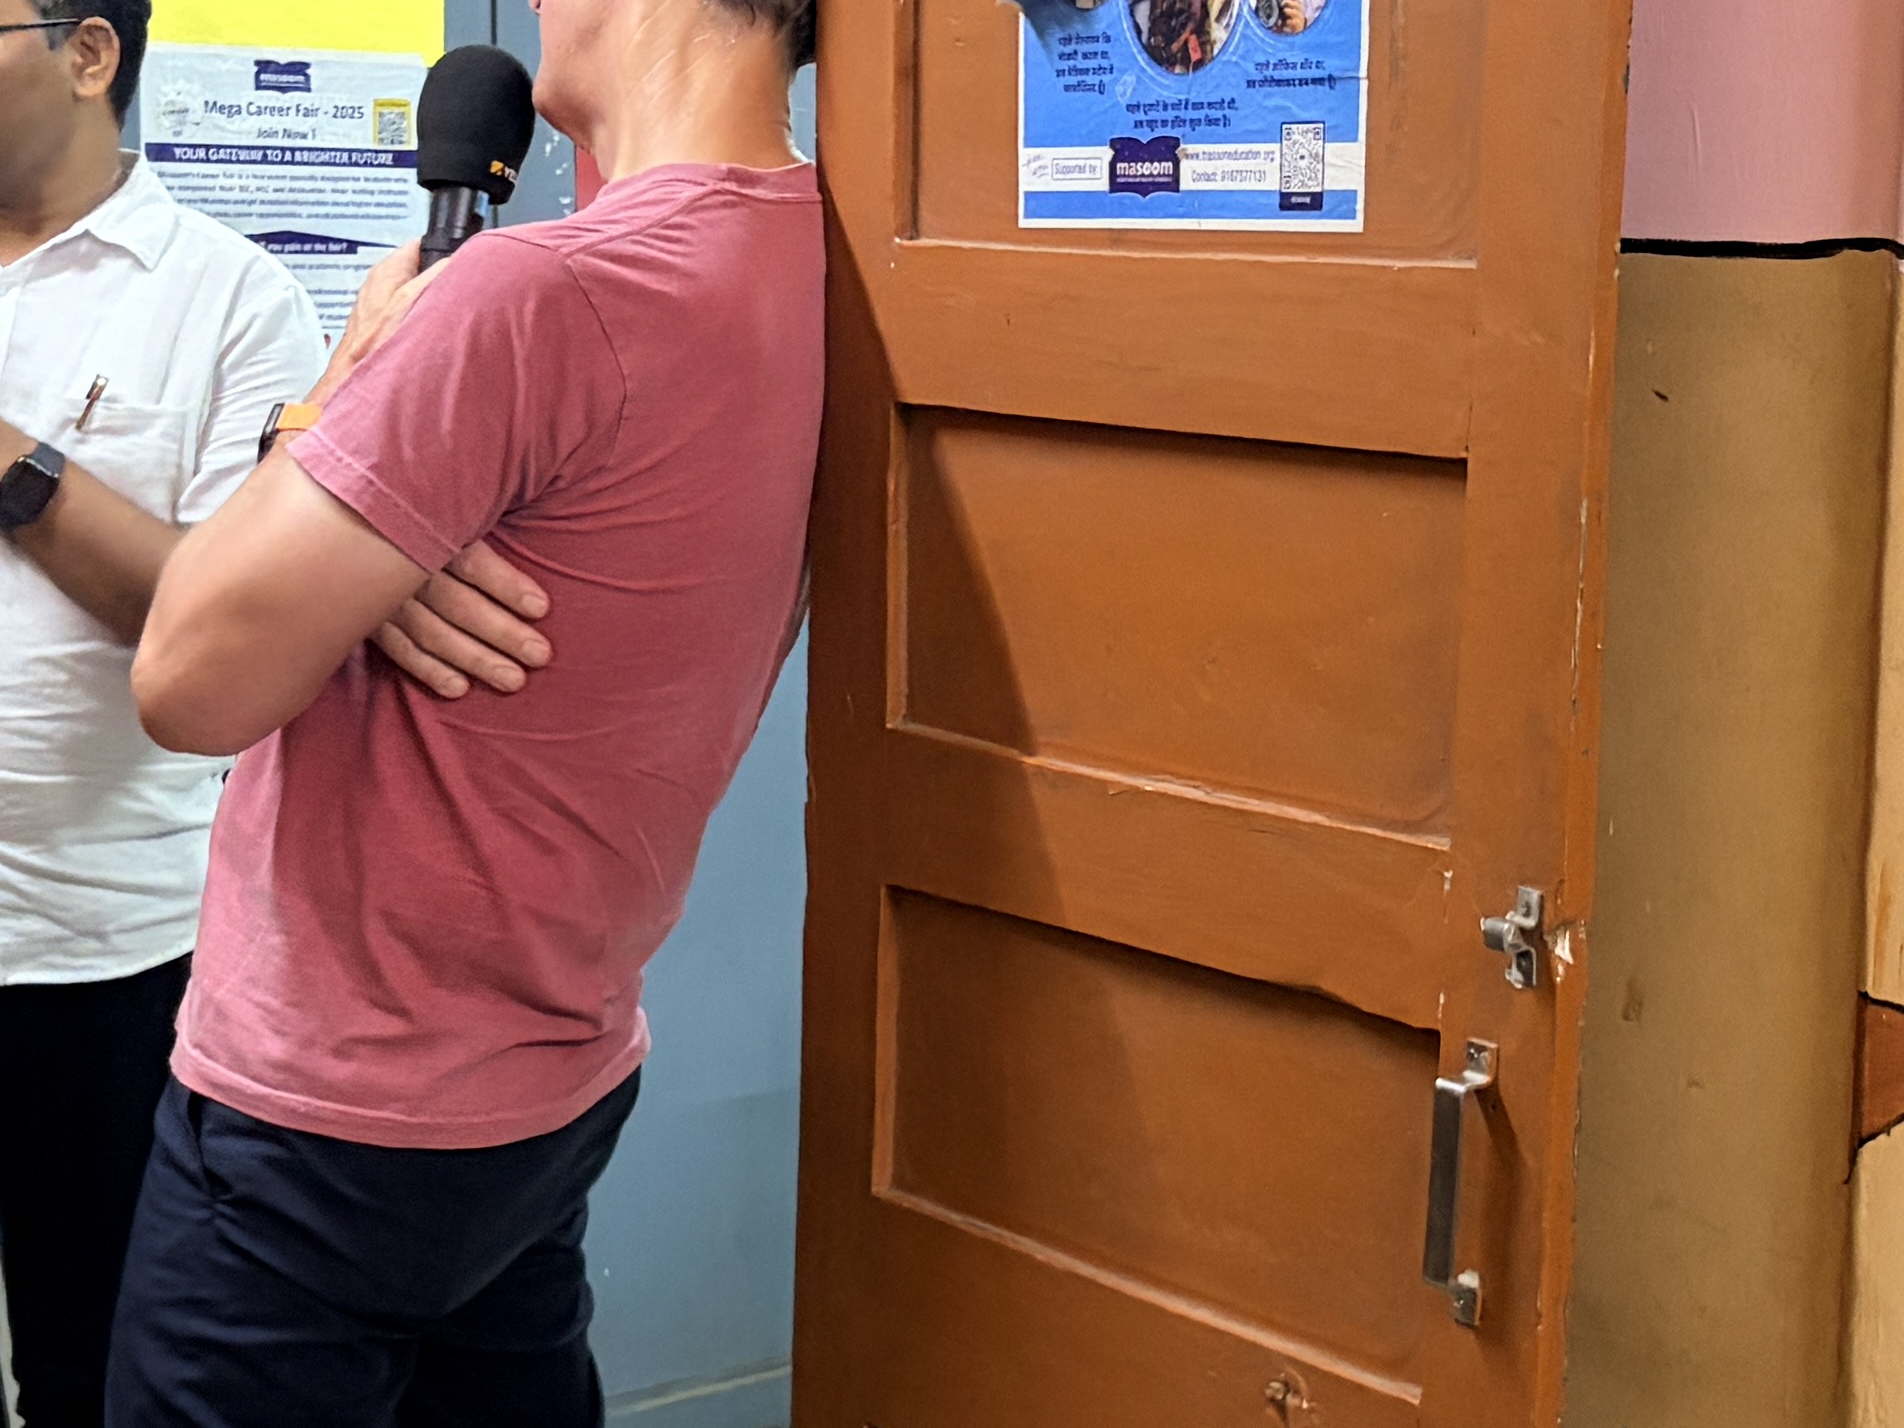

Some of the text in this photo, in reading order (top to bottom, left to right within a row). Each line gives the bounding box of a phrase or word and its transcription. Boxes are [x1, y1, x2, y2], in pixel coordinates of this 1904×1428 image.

[204, 100, 242, 118] Mega
[246, 102, 290, 117] Career
[295, 103, 320, 118] Fair
[332, 105, 365, 120] 2025
[174, 147, 206, 159] YOUR
[266, 149, 282, 162] TO
[283, 150, 292, 162] A
[1117, 160, 1173, 176] masoom
